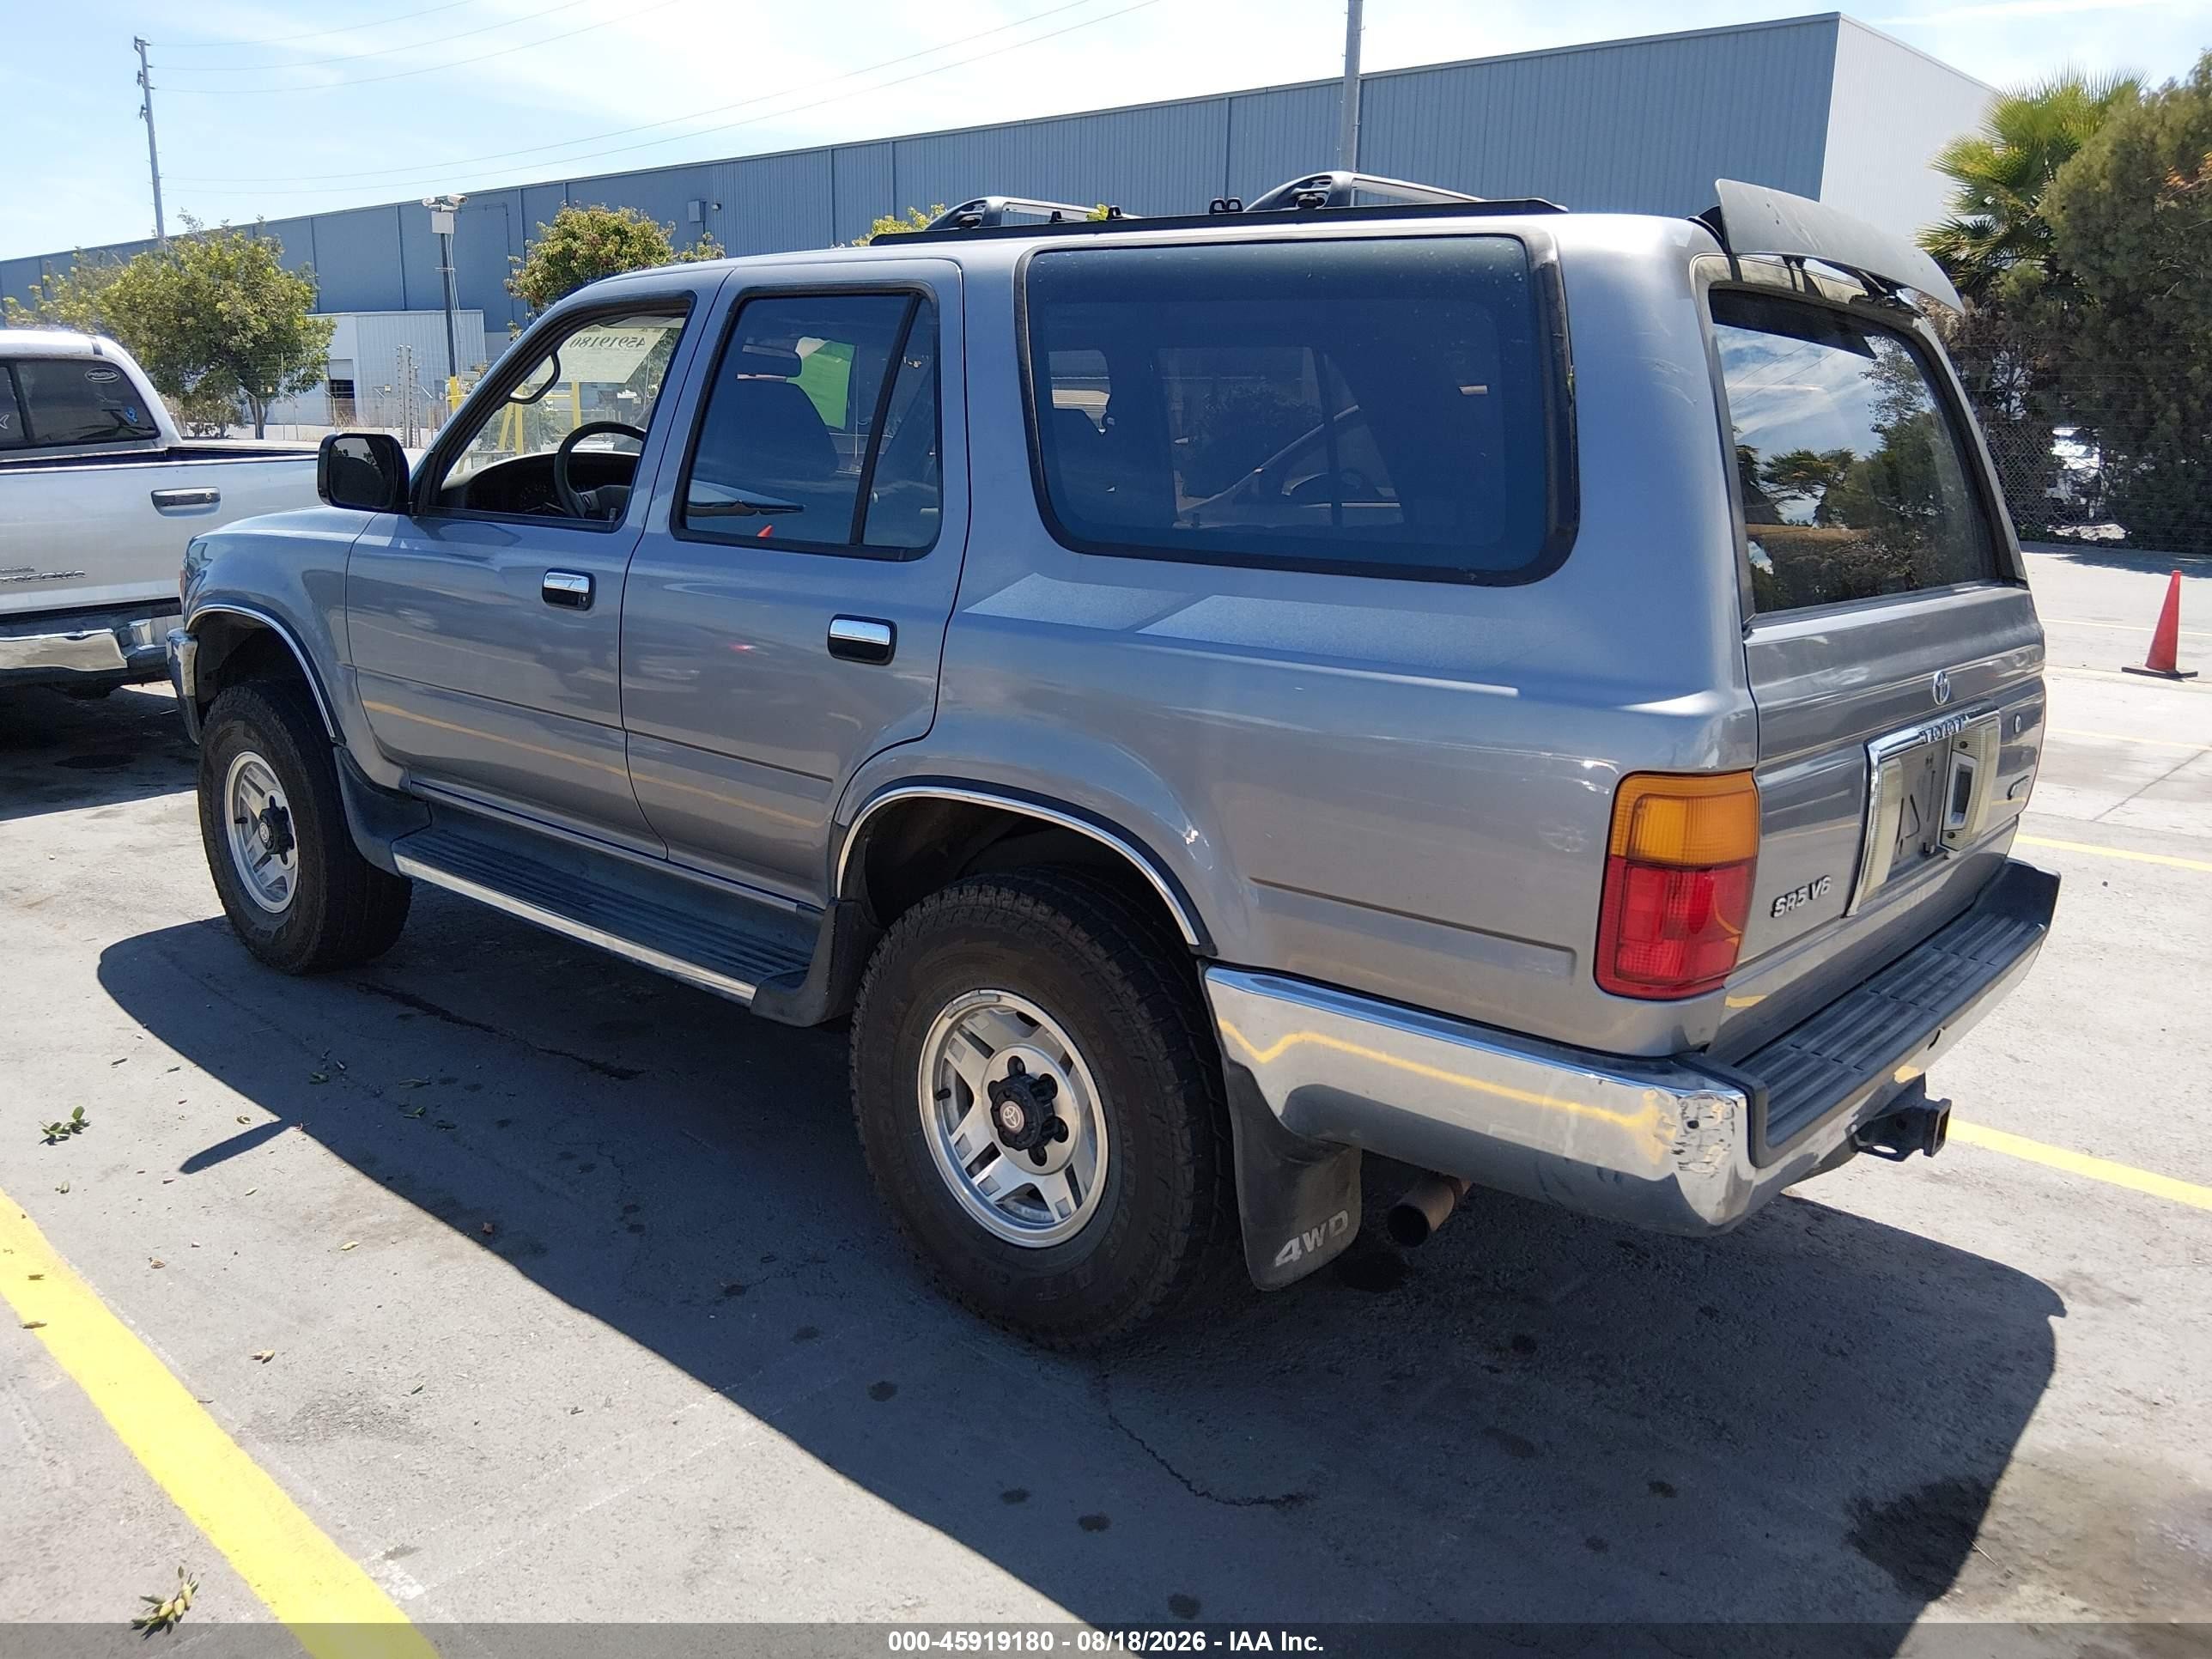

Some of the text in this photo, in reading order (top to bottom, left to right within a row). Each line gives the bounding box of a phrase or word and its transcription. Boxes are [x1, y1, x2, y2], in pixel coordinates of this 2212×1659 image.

[1771, 874, 1832, 918] SR5 V6
[1274, 1209, 1349, 1267] 4WD
